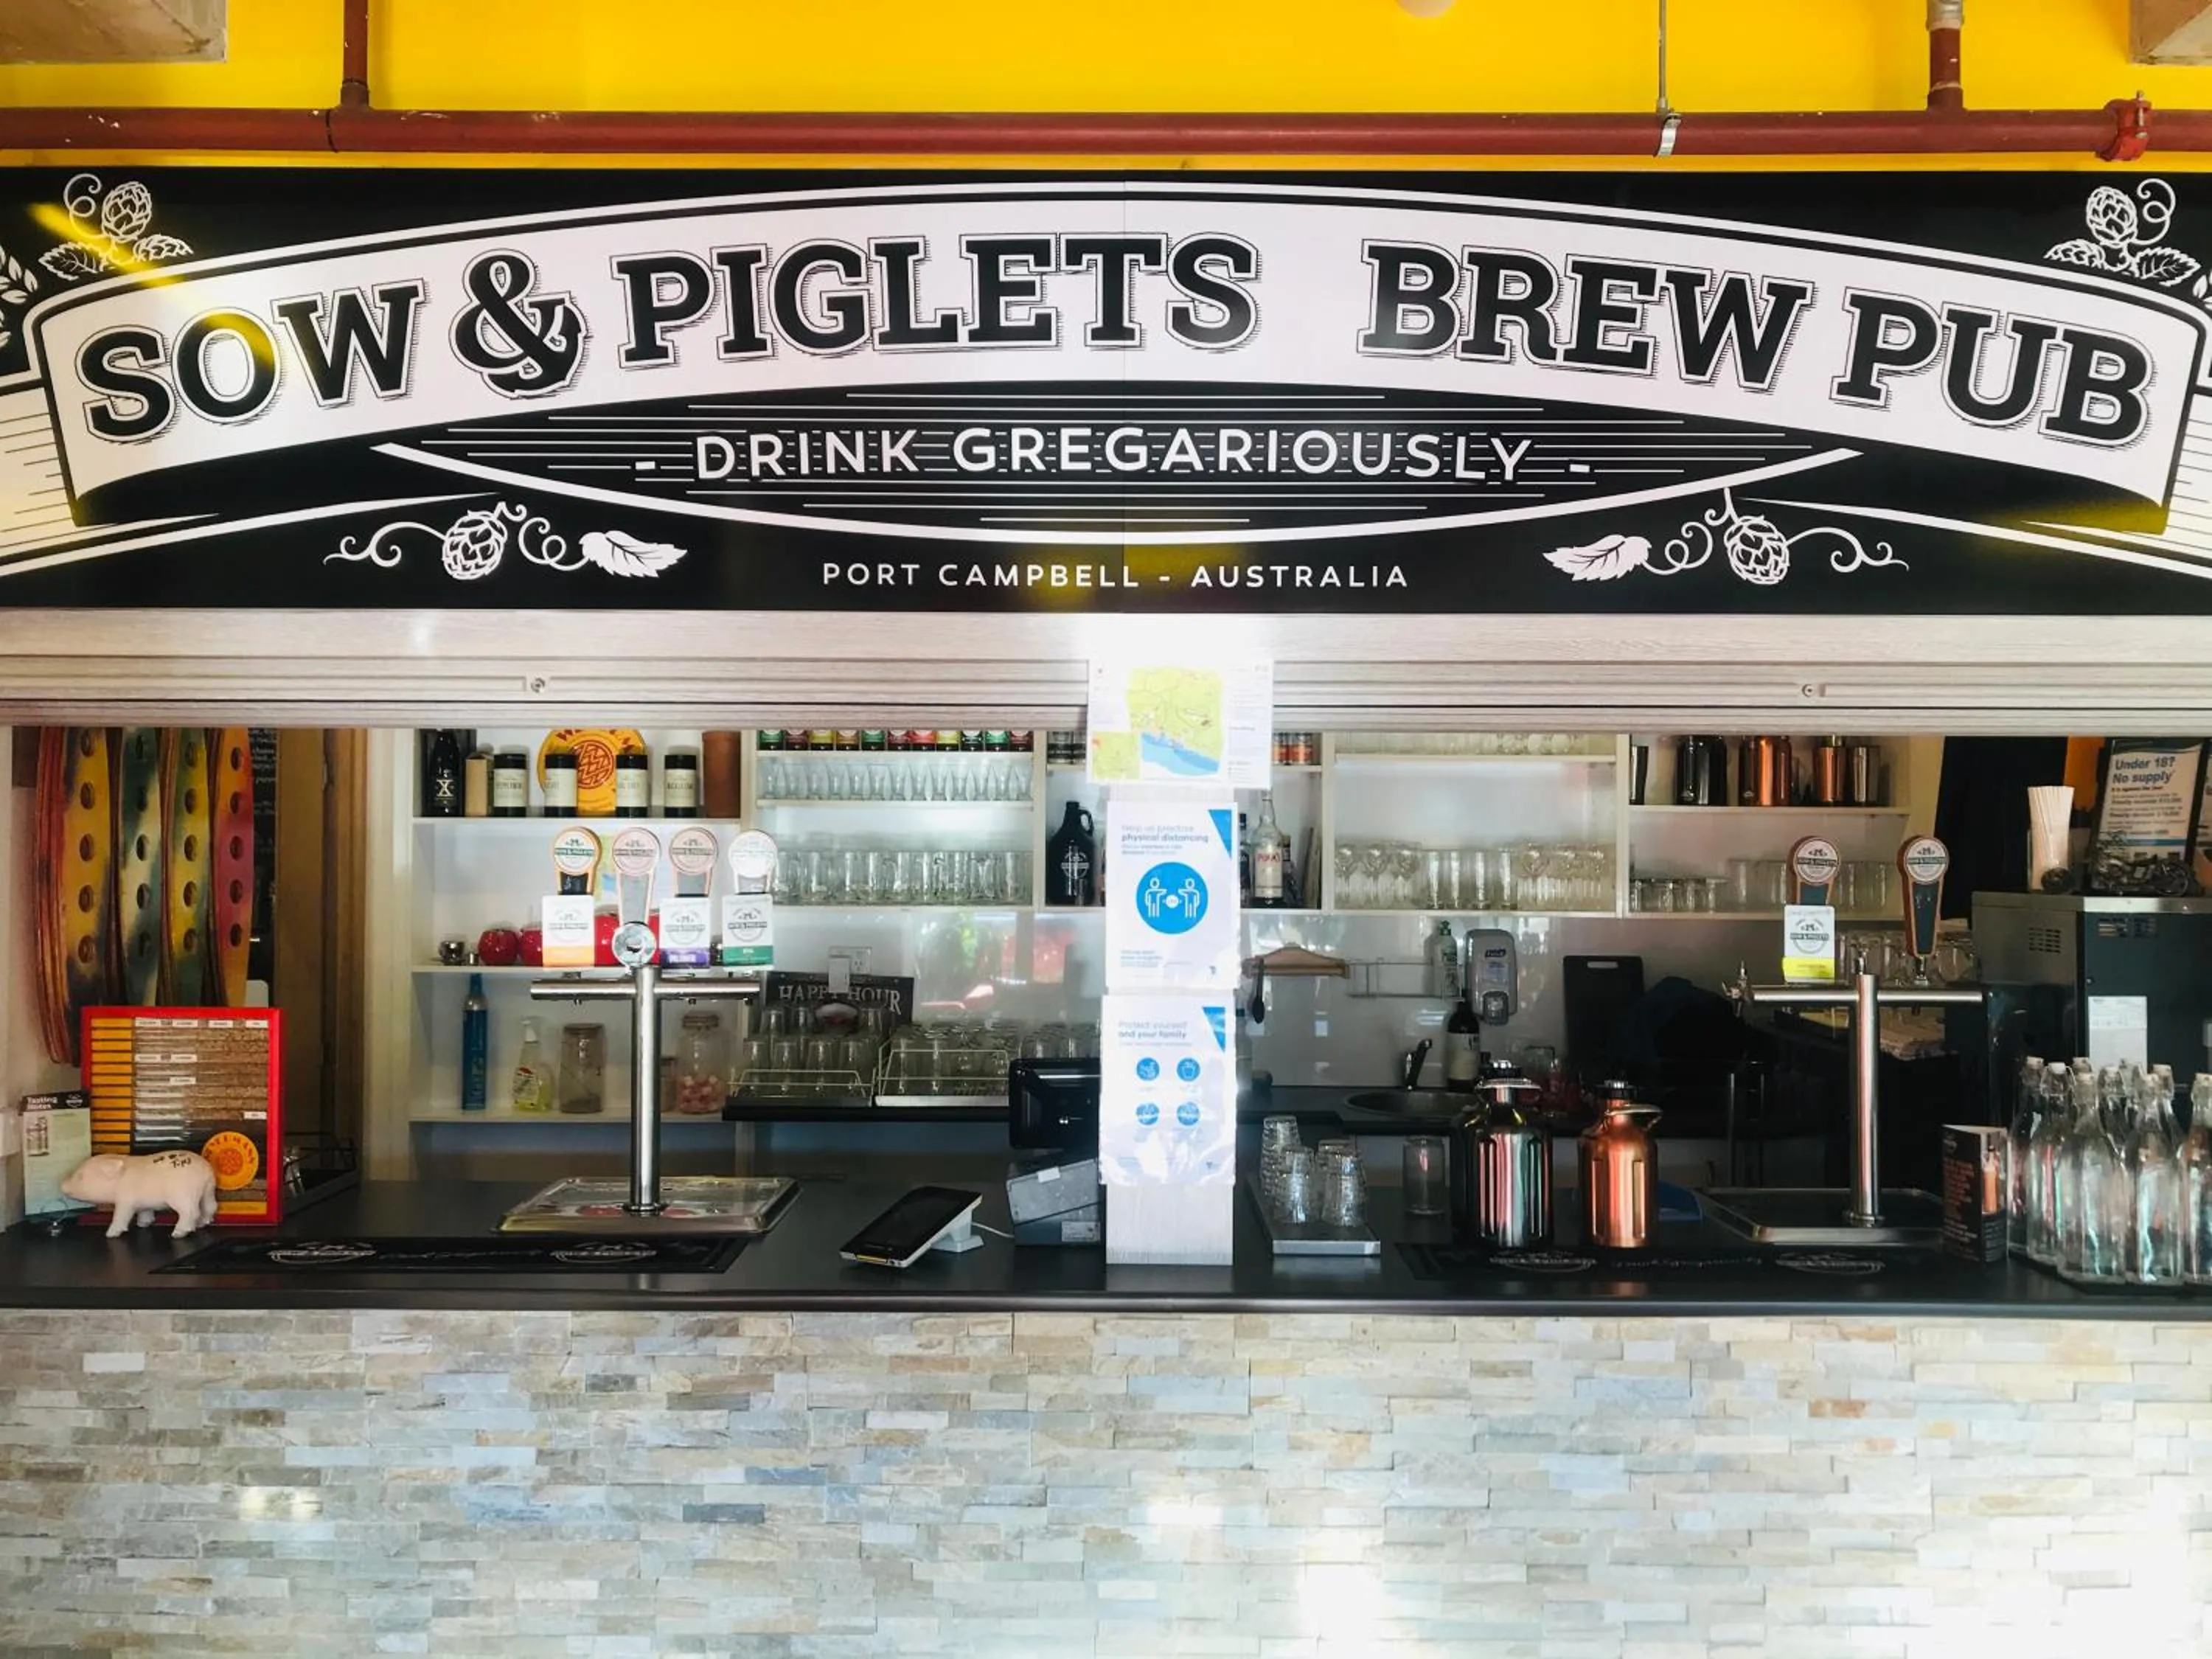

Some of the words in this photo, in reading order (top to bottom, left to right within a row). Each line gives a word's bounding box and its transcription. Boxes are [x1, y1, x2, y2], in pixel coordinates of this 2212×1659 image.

[75, 278, 429, 444] SOW
[448, 248, 592, 400] &
[609, 232, 1262, 370] PIGLETS
[1357, 238, 1819, 396] BREW
[1829, 287, 2157, 451] PUB
[696, 428, 920, 480] DRINK
[953, 427, 1532, 482] GREGARIOUSLY
[822, 562, 921, 586] PORT
[938, 563, 1140, 588] CAMPBELL
[1190, 565, 1408, 588] AUSTRALIA
[2115, 758, 2152, 771] Under
[2154, 756, 2176, 768] 18?
[2112, 772, 2129, 784] No
[1121, 833, 1160, 843] physical
[1161, 832, 1208, 844] distancing
[779, 984, 838, 1001] HAPP
[847, 985, 902, 1015] HOUR
